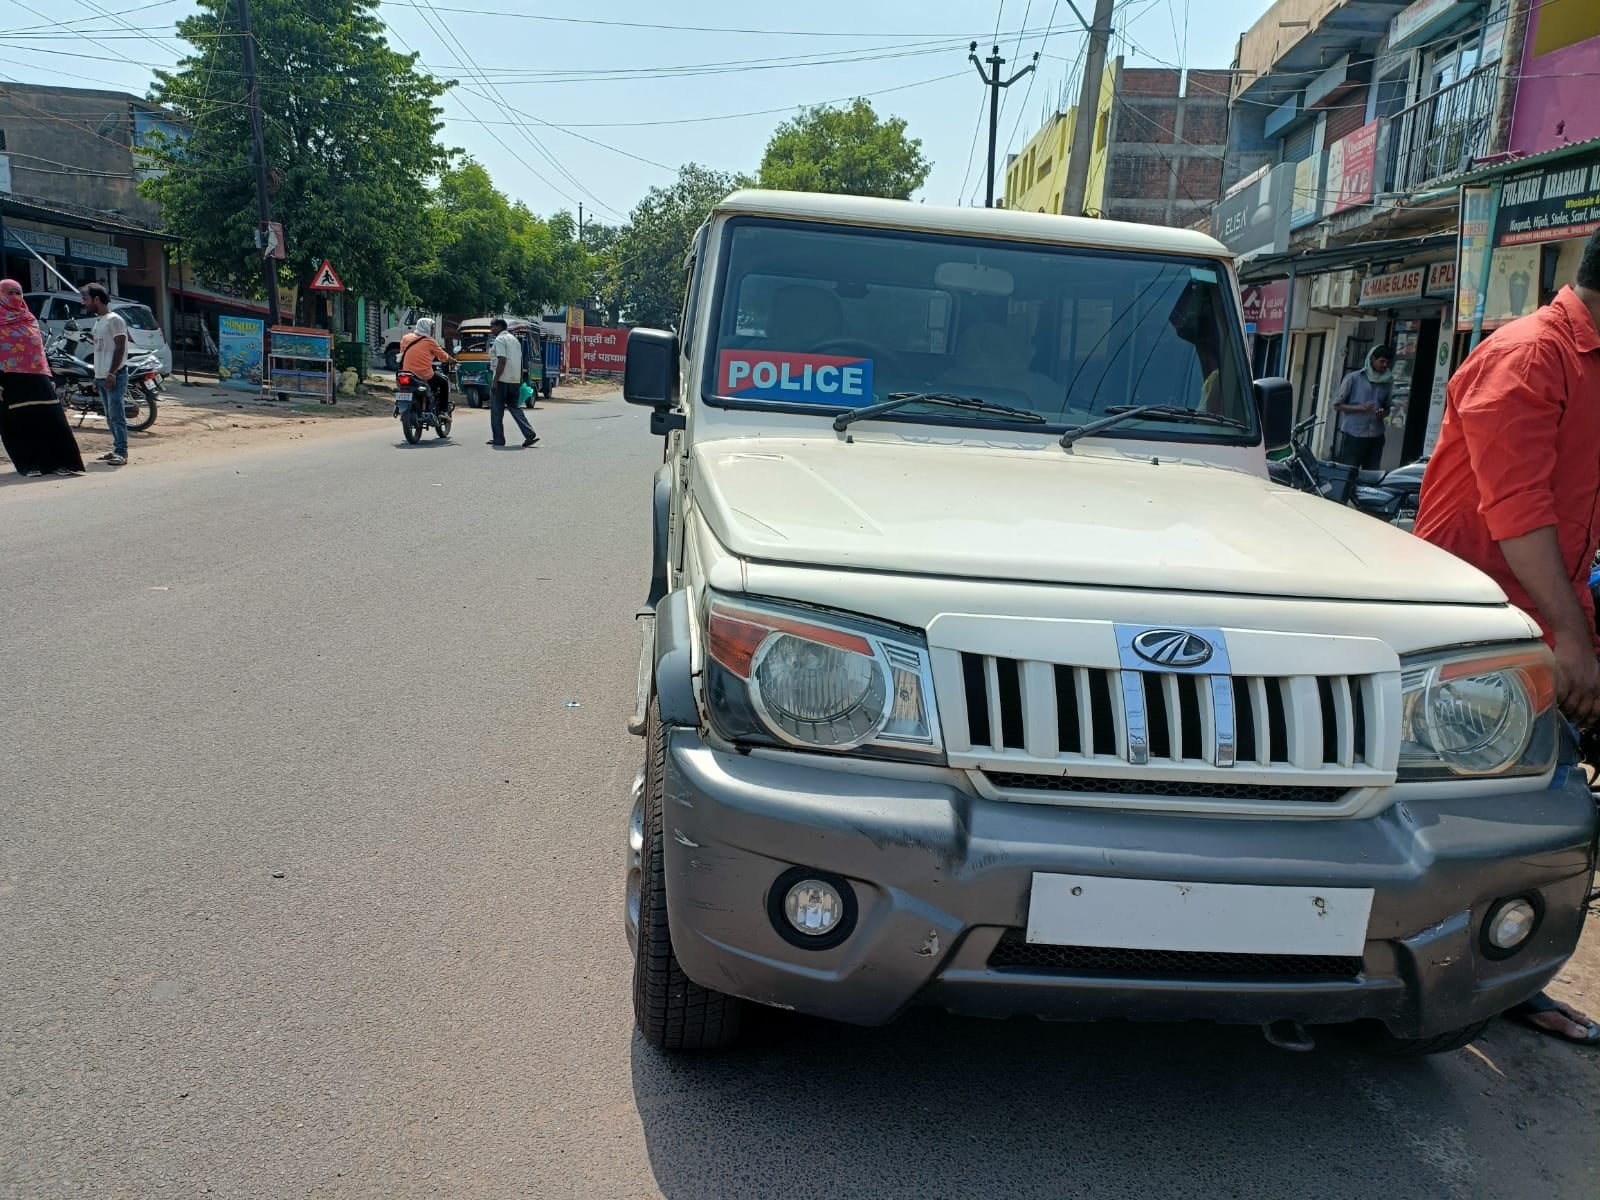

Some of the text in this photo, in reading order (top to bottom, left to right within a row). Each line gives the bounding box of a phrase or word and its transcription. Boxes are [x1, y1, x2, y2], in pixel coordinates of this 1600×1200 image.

[1500, 177, 1542, 208] FULWARI
[1542, 167, 1588, 200] ARABIAN
[1565, 197, 1595, 209] Wholesale
[1225, 209, 1247, 236] ELISA
[1391, 271, 1420, 292] GLASS
[1430, 266, 1438, 285] &
[604, 334, 617, 345] की
[728, 360, 864, 396] POLICE
